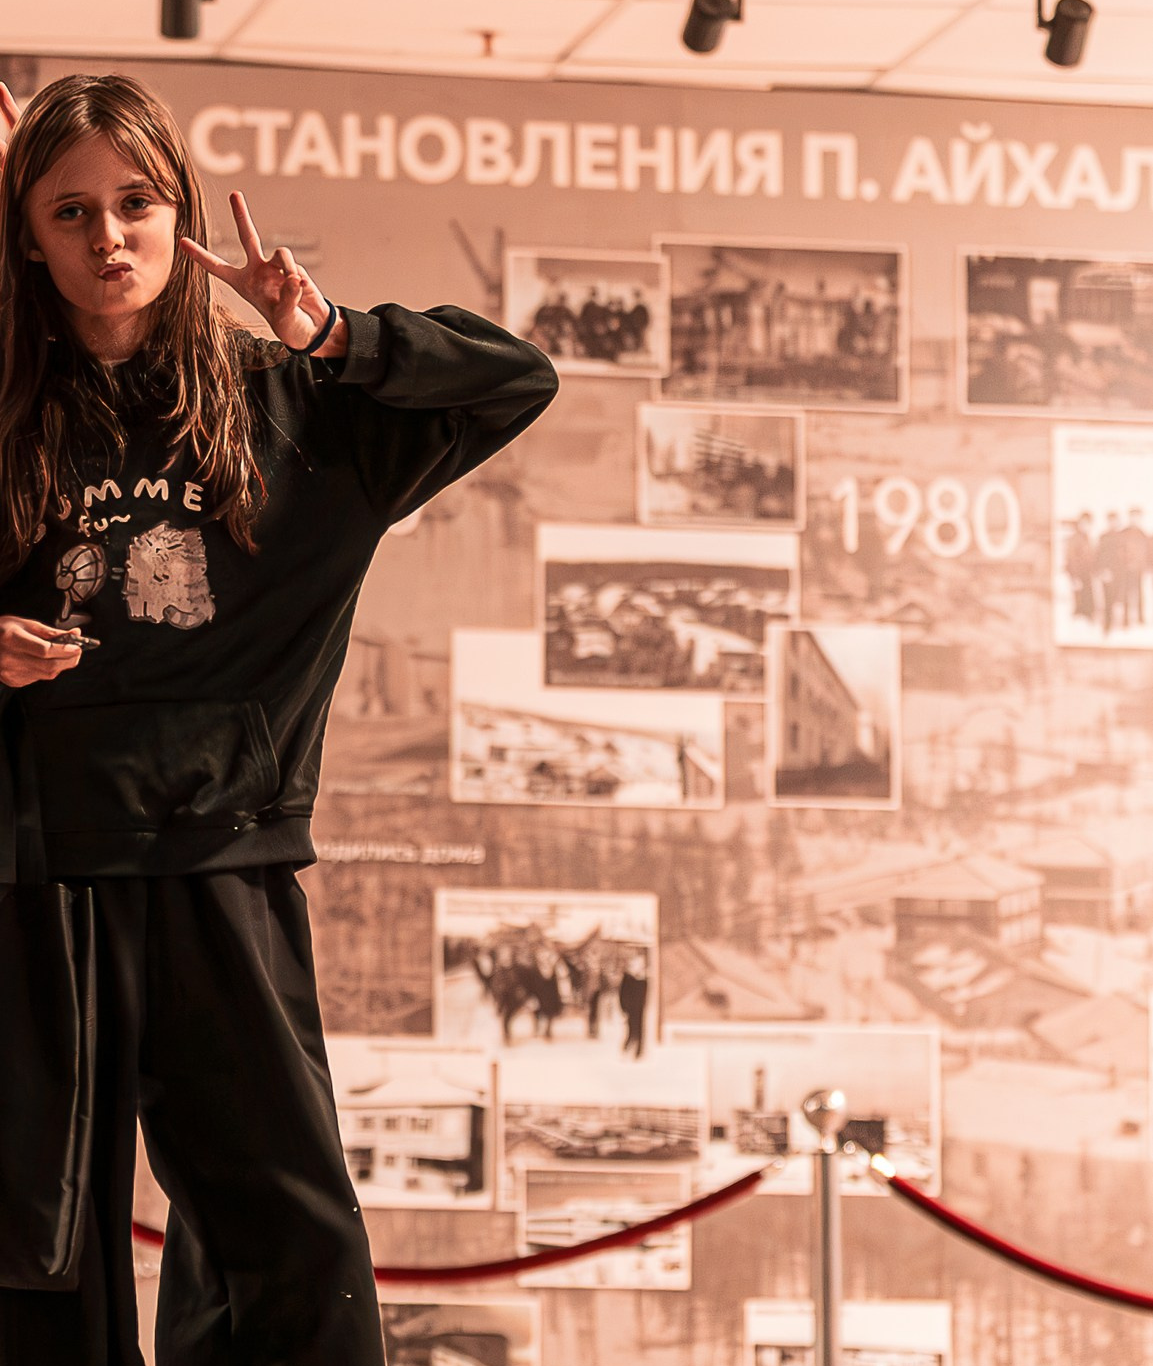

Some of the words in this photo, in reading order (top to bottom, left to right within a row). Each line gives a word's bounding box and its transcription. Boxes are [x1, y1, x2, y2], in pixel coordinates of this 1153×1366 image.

[189, 104, 784, 200] СТАНОВЛЕНИЯ
[802, 131, 880, 202] П.
[830, 475, 1021, 559] 1980
